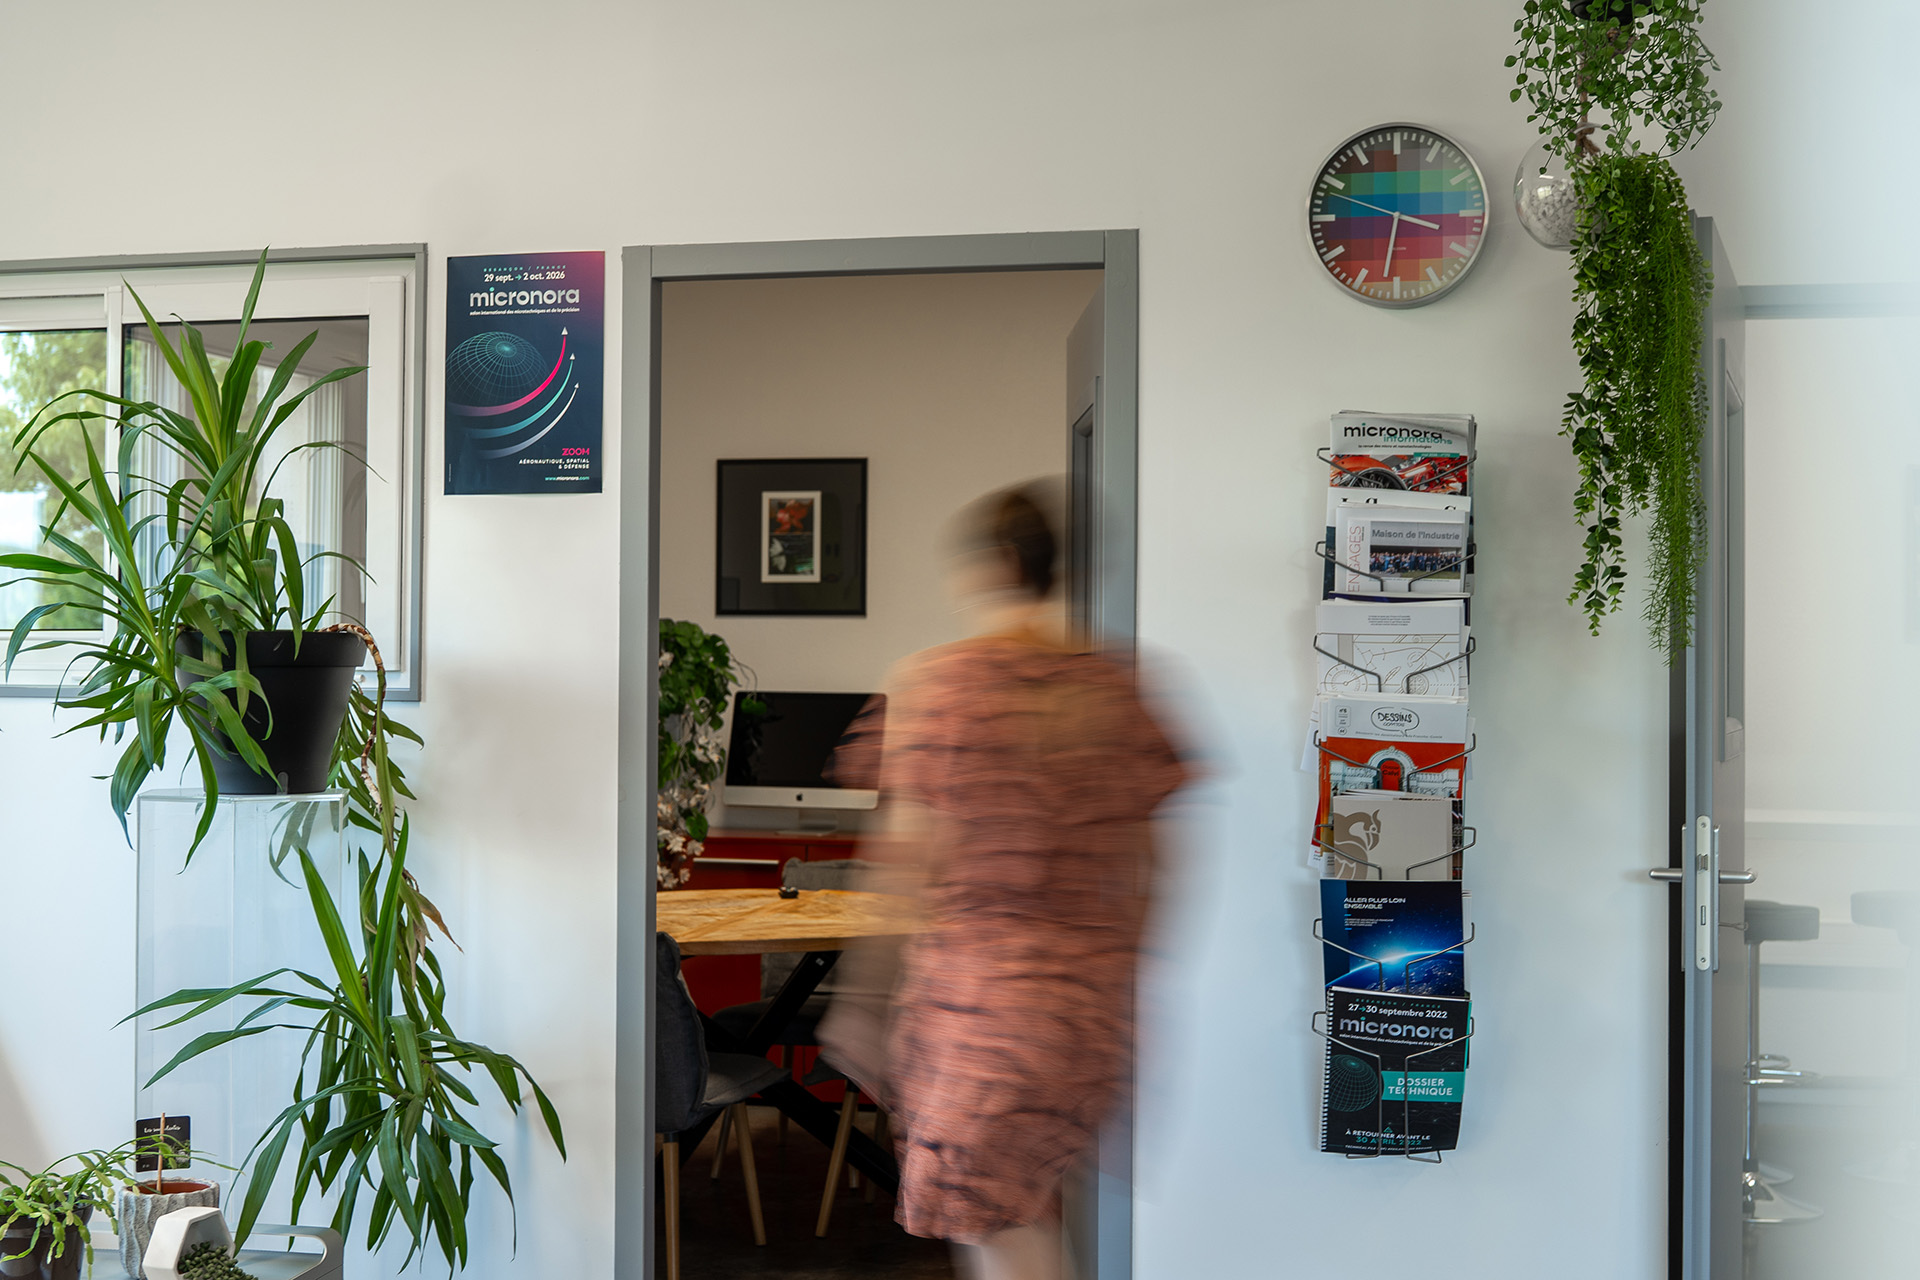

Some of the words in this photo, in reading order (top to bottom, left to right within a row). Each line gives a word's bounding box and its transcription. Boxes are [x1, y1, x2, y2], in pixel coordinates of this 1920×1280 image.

[484, 273, 495, 282] 29
[495, 274, 514, 283] sept.
[523, 272, 529, 280] 2
[529, 272, 545, 280] oct.
[545, 271, 566, 280] 2026
[469, 286, 580, 307] micronora
[1344, 422, 1442, 439] micronora
[1383, 433, 1453, 445] informations
[562, 448, 590, 456] ZOOM
[1371, 528, 1404, 538] Maison
[1405, 530, 1416, 539] de
[1377, 711, 1412, 723] DESSINS
[1378, 1007, 1424, 1017] septembre
[1425, 1010, 1448, 1019] 2022
[1339, 1016, 1454, 1040] micronora
[1397, 1077, 1444, 1087] DOSSIER
[1352, 1130, 1395, 1139] RETOUNER
